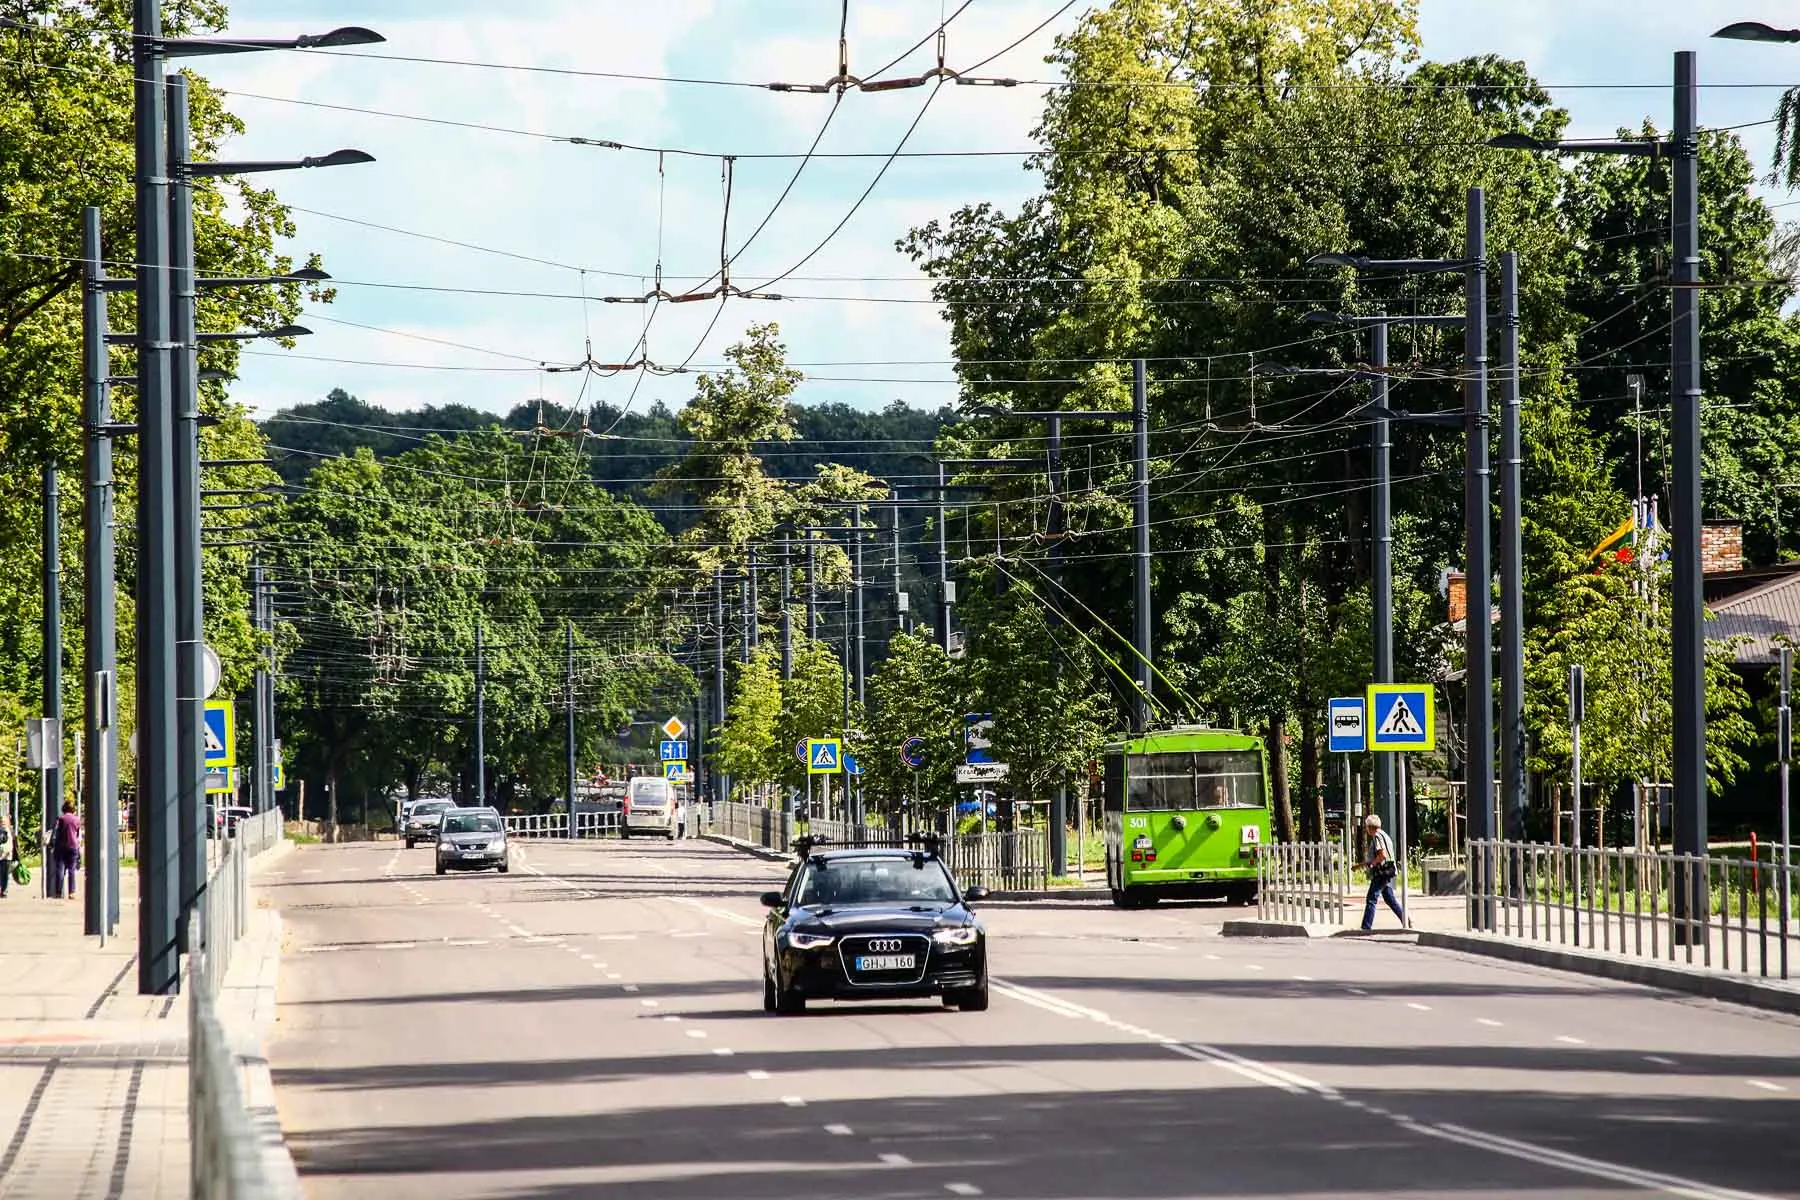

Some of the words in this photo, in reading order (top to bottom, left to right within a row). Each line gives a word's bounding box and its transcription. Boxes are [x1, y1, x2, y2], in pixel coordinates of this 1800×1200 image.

[1248, 828, 1255, 840] 4
[863, 959, 886, 969] GHJ
[895, 957, 913, 967] 160
